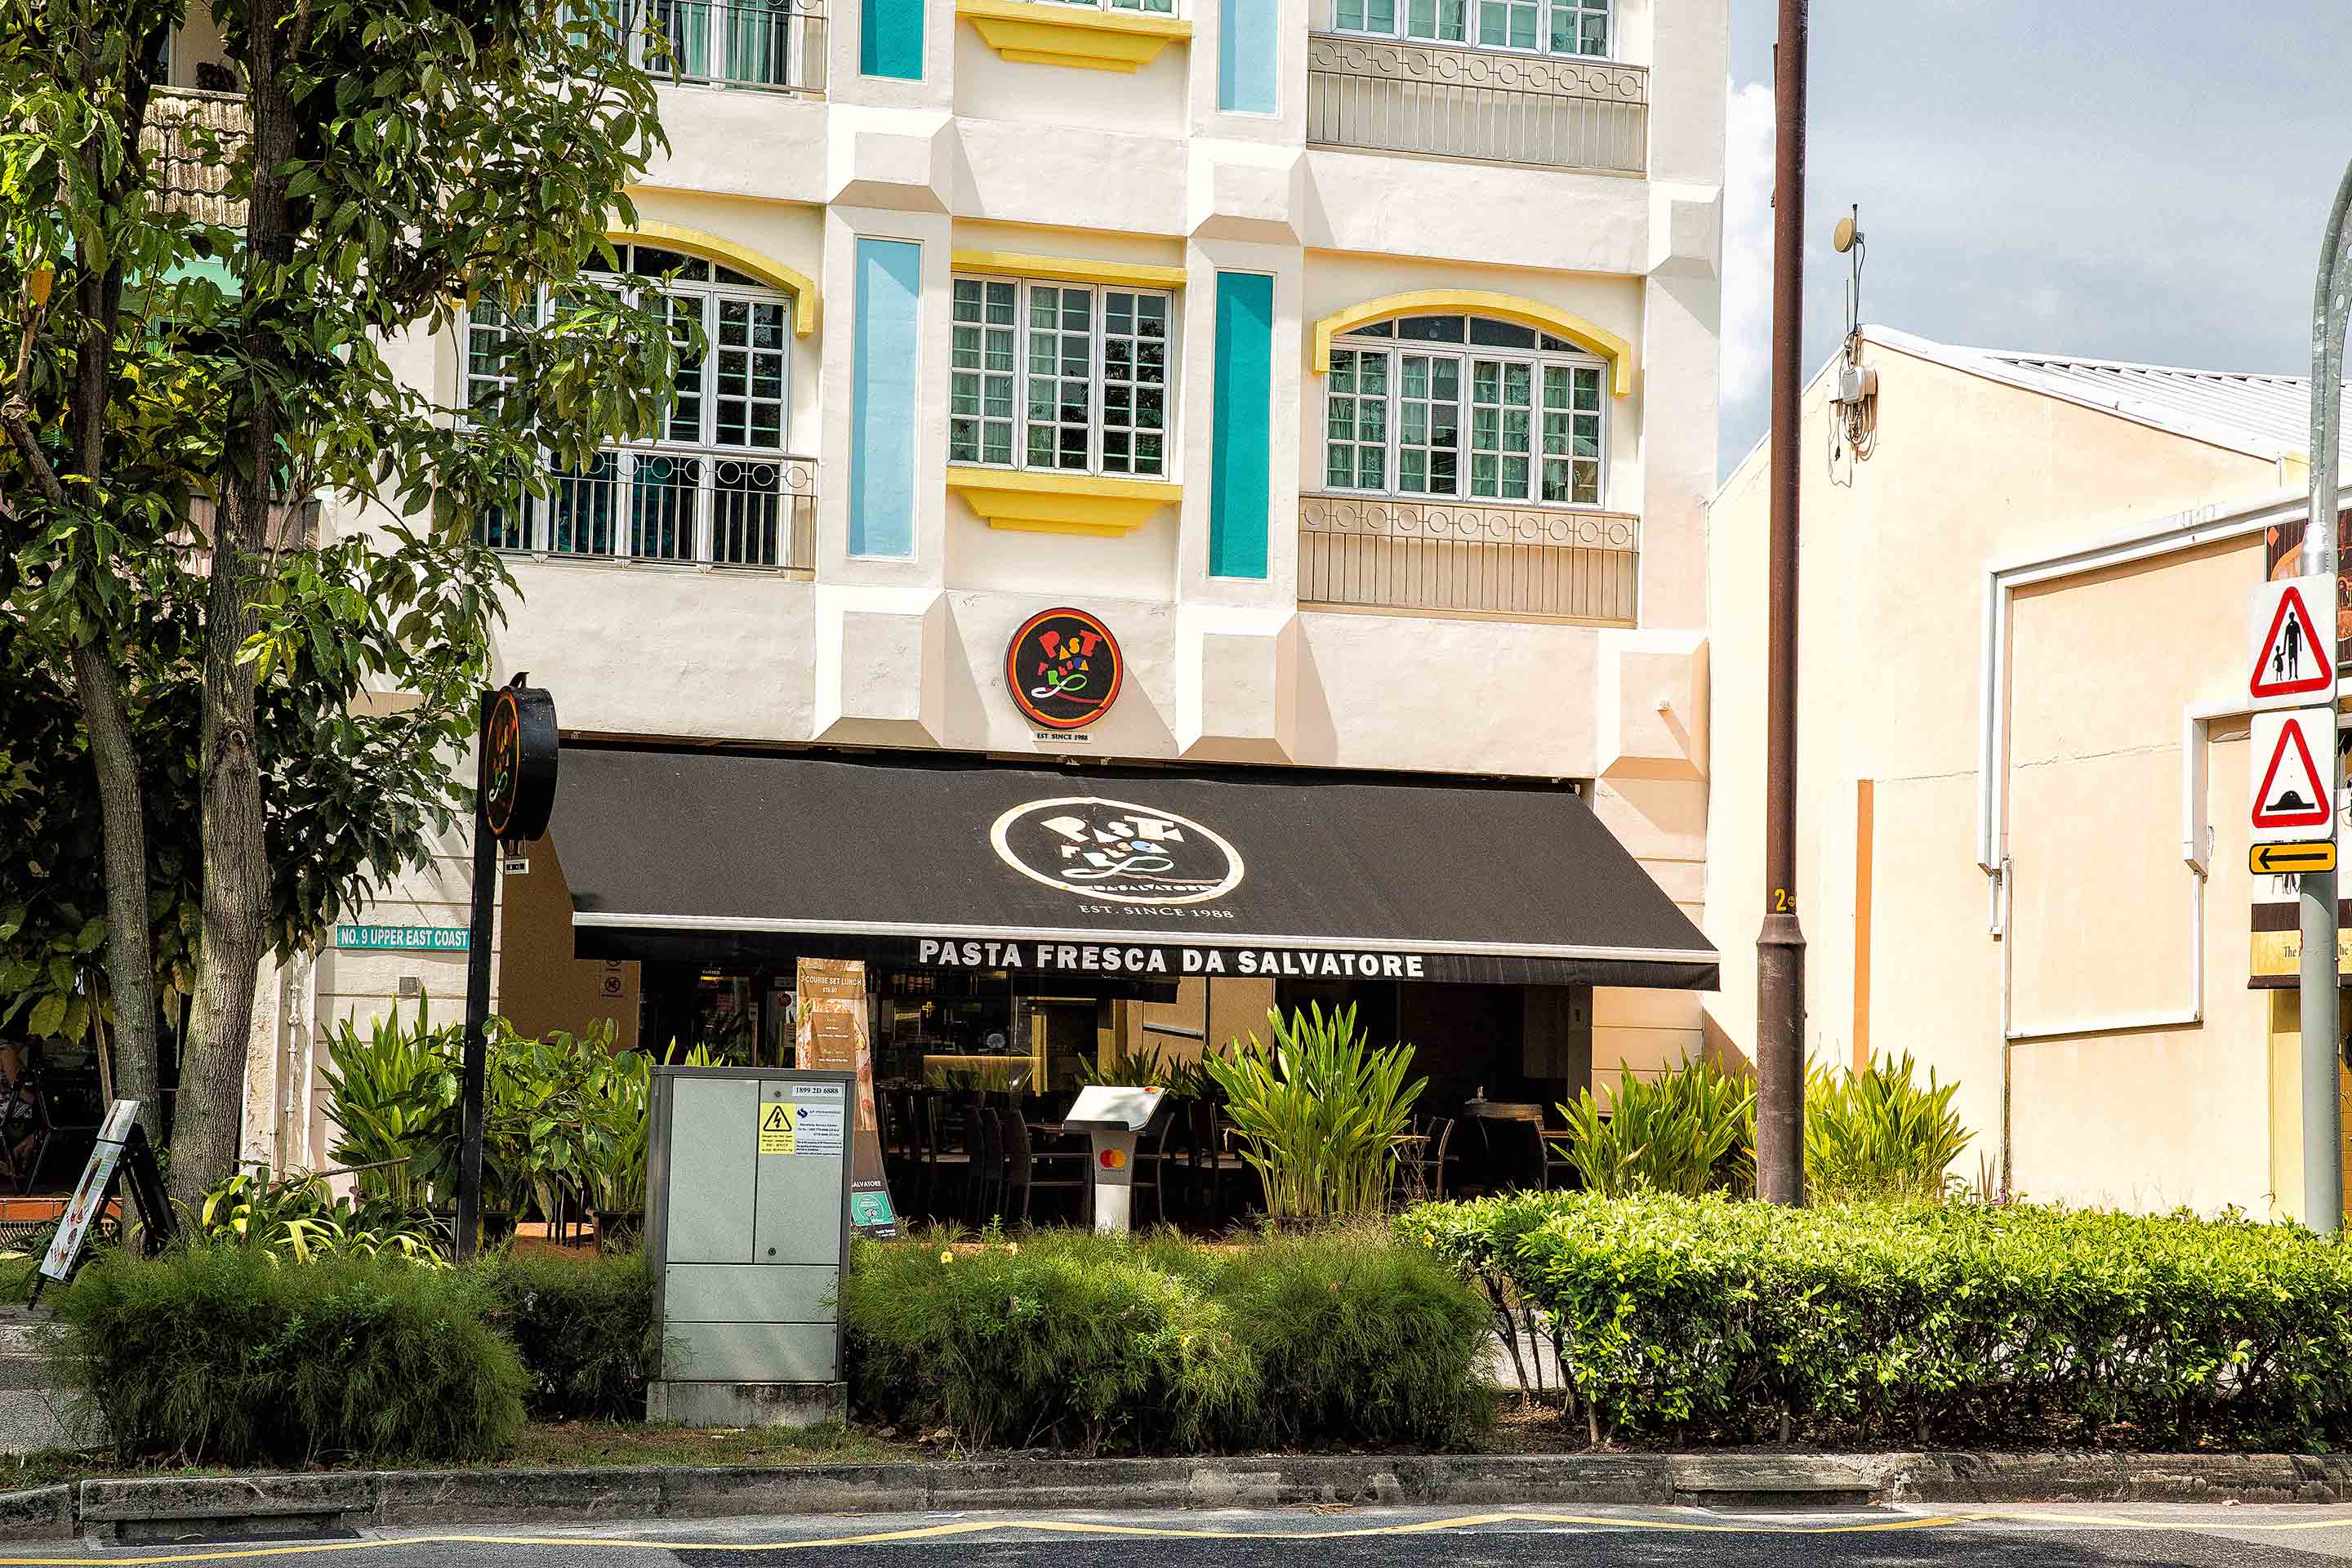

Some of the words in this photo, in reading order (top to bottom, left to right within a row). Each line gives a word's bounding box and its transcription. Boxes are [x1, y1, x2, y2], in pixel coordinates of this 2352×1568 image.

[1040, 815, 1185, 844] PASTA
[1079, 905, 1119, 914] EST.
[1125, 906, 1185, 916] SINCE
[1191, 909, 1235, 919] 1988
[341, 929, 359, 945] NO.
[361, 929, 368, 945] 9
[371, 929, 404, 946] UPPER
[406, 929, 432, 947] EAST
[434, 930, 468, 947] COAST
[919, 939, 1022, 968] PASTA
[1036, 944, 1167, 973] FRESCA
[1183, 948, 1226, 973] DA
[1237, 950, 1425, 978] SALVATORE
[2283, 946, 2296, 958] The
[829, 977, 840, 985] SET
[841, 978, 862, 986] LUNCH
